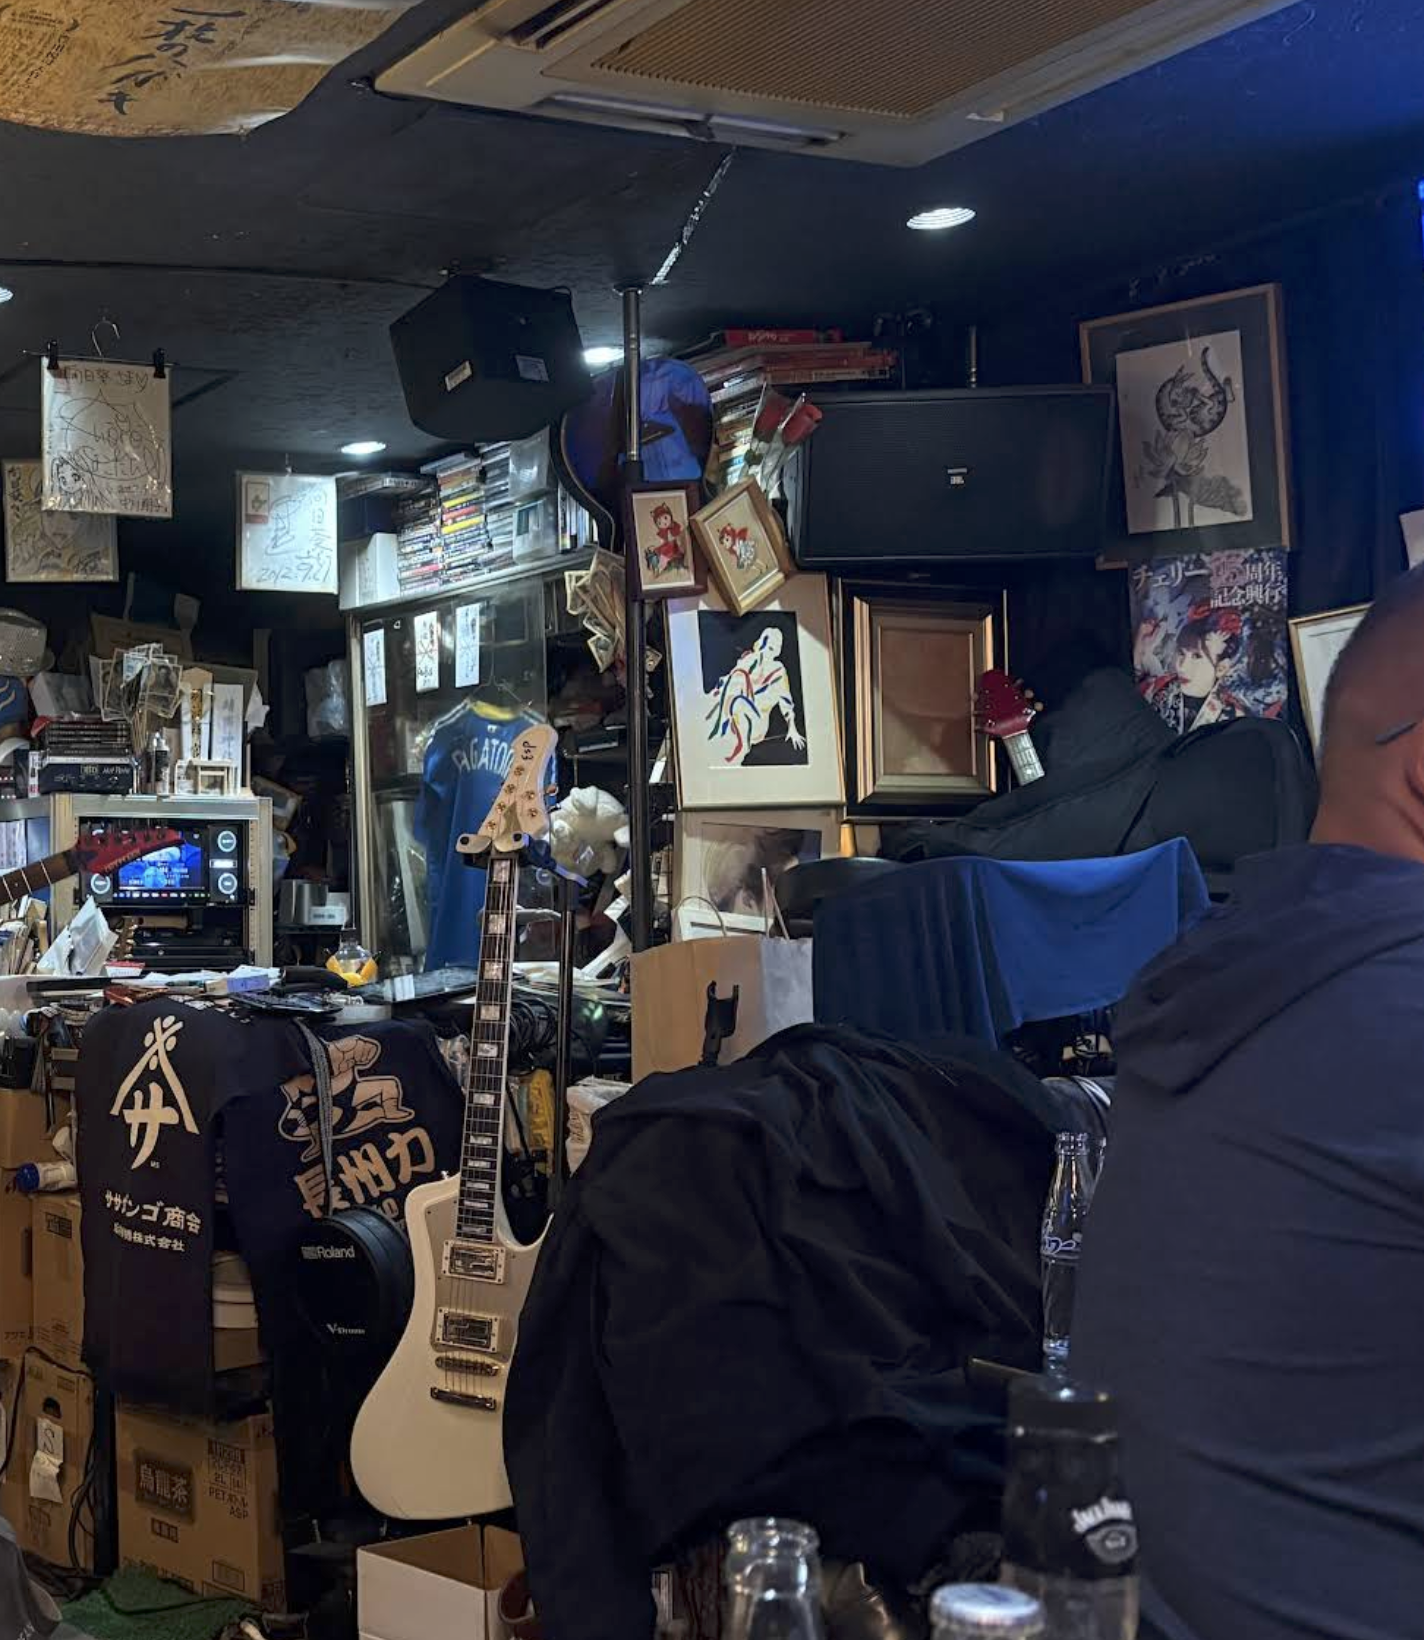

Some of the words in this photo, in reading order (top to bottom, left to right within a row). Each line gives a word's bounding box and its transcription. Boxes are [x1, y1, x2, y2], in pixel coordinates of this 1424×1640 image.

[294, 1126, 435, 1219] 長州力
[317, 1245, 356, 1259] Roland
[139, 1462, 188, 1505] 烏龍茶
